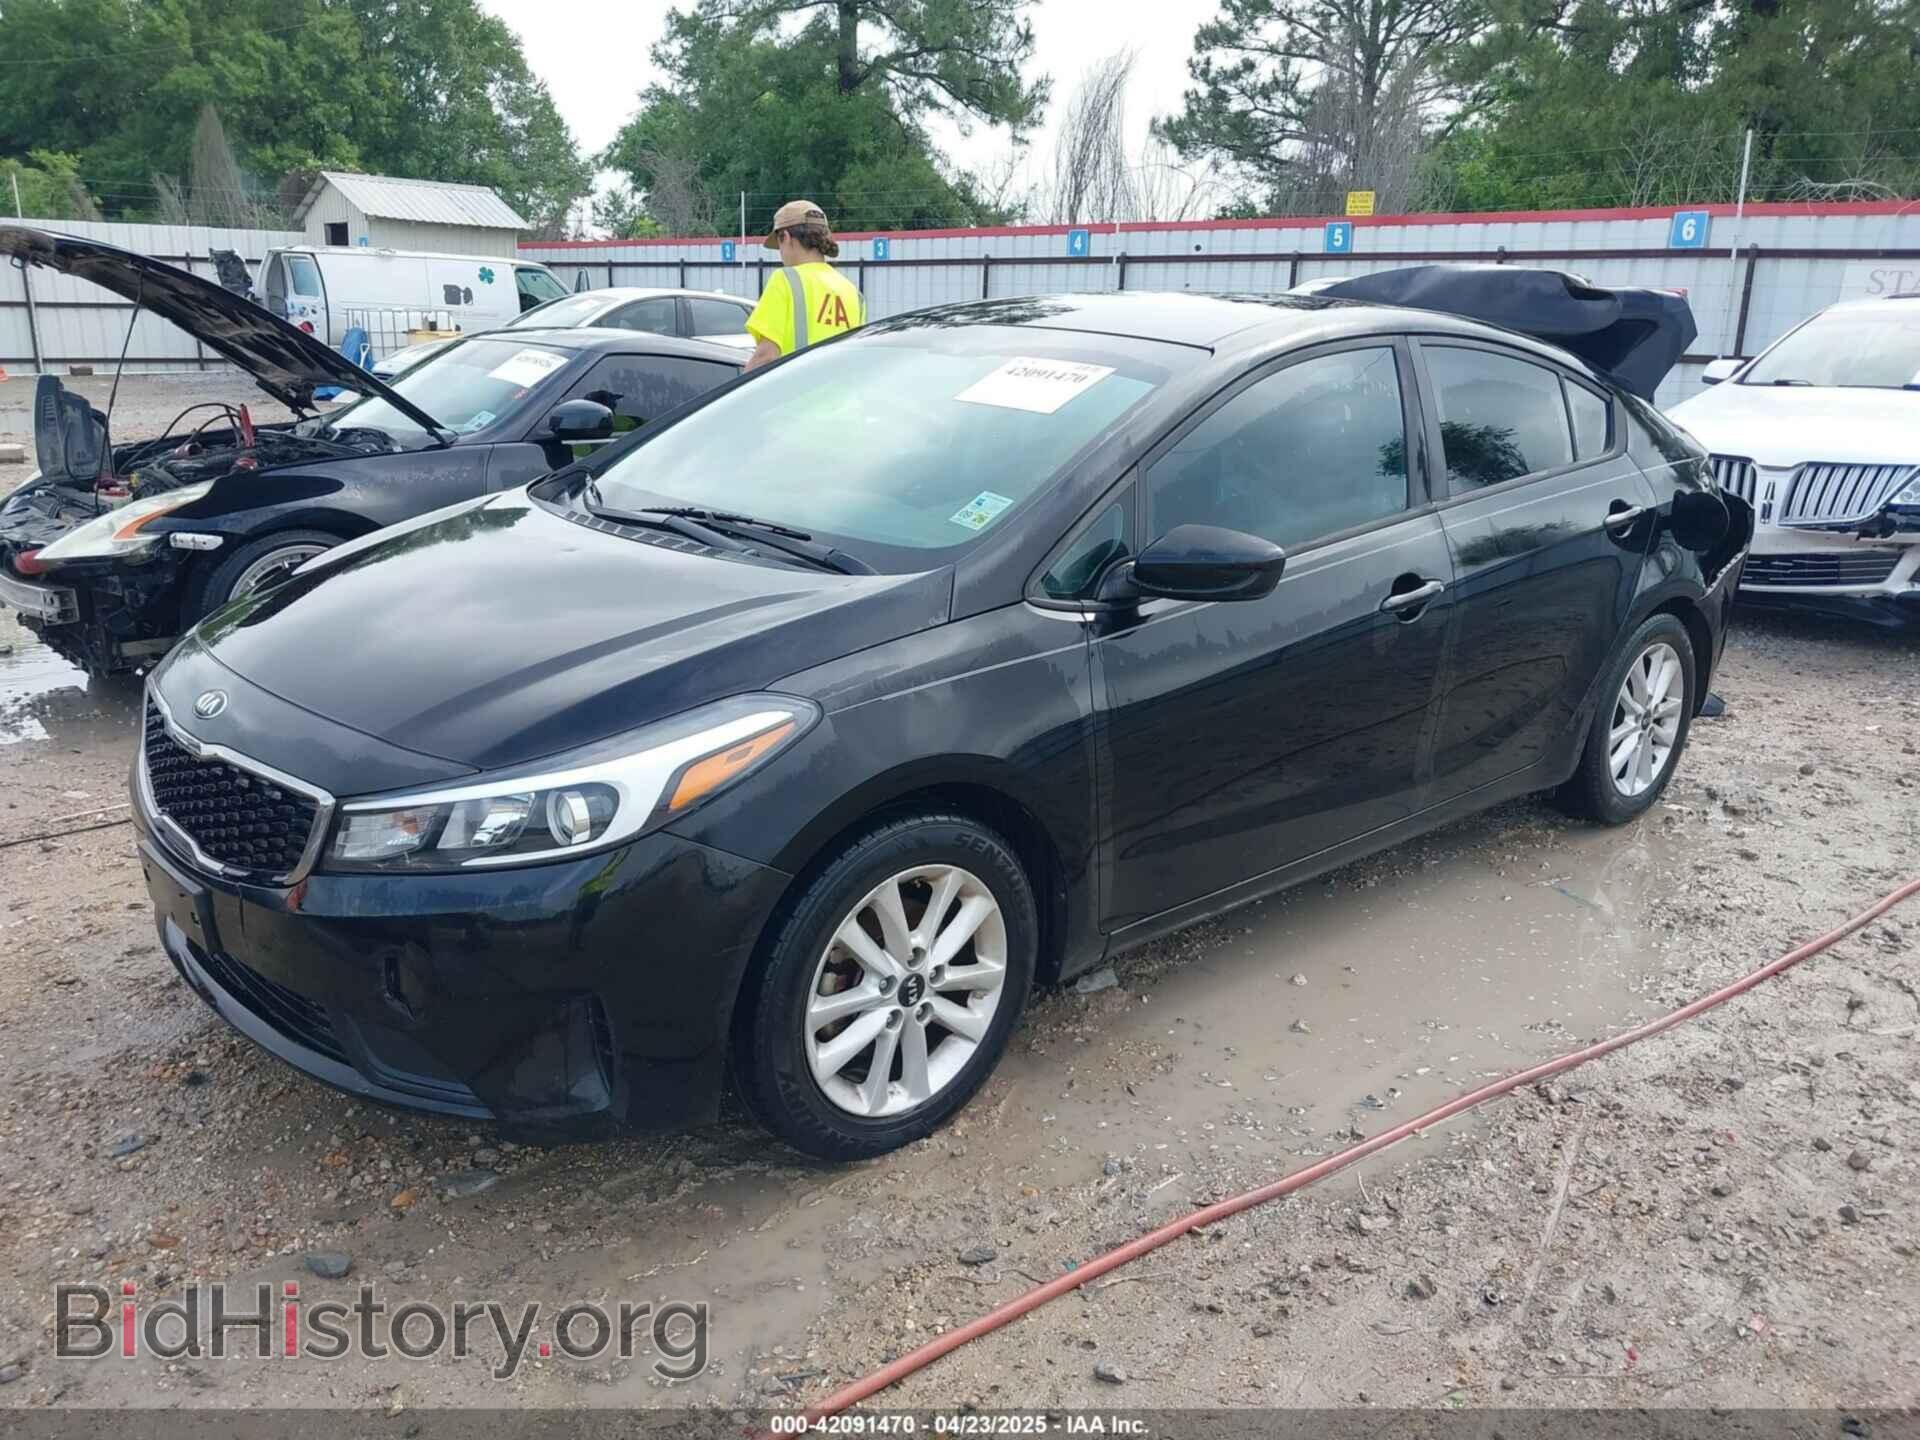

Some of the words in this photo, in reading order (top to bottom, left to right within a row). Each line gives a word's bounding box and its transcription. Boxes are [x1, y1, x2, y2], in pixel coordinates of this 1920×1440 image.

[1333, 227, 1343, 247] 5
[1682, 217, 1696, 241] 6
[877, 242, 884, 256] 3
[1073, 233, 1082, 251] 4
[1006, 367, 1088, 383] 42091470
[908, 975, 918, 1006] KIA
